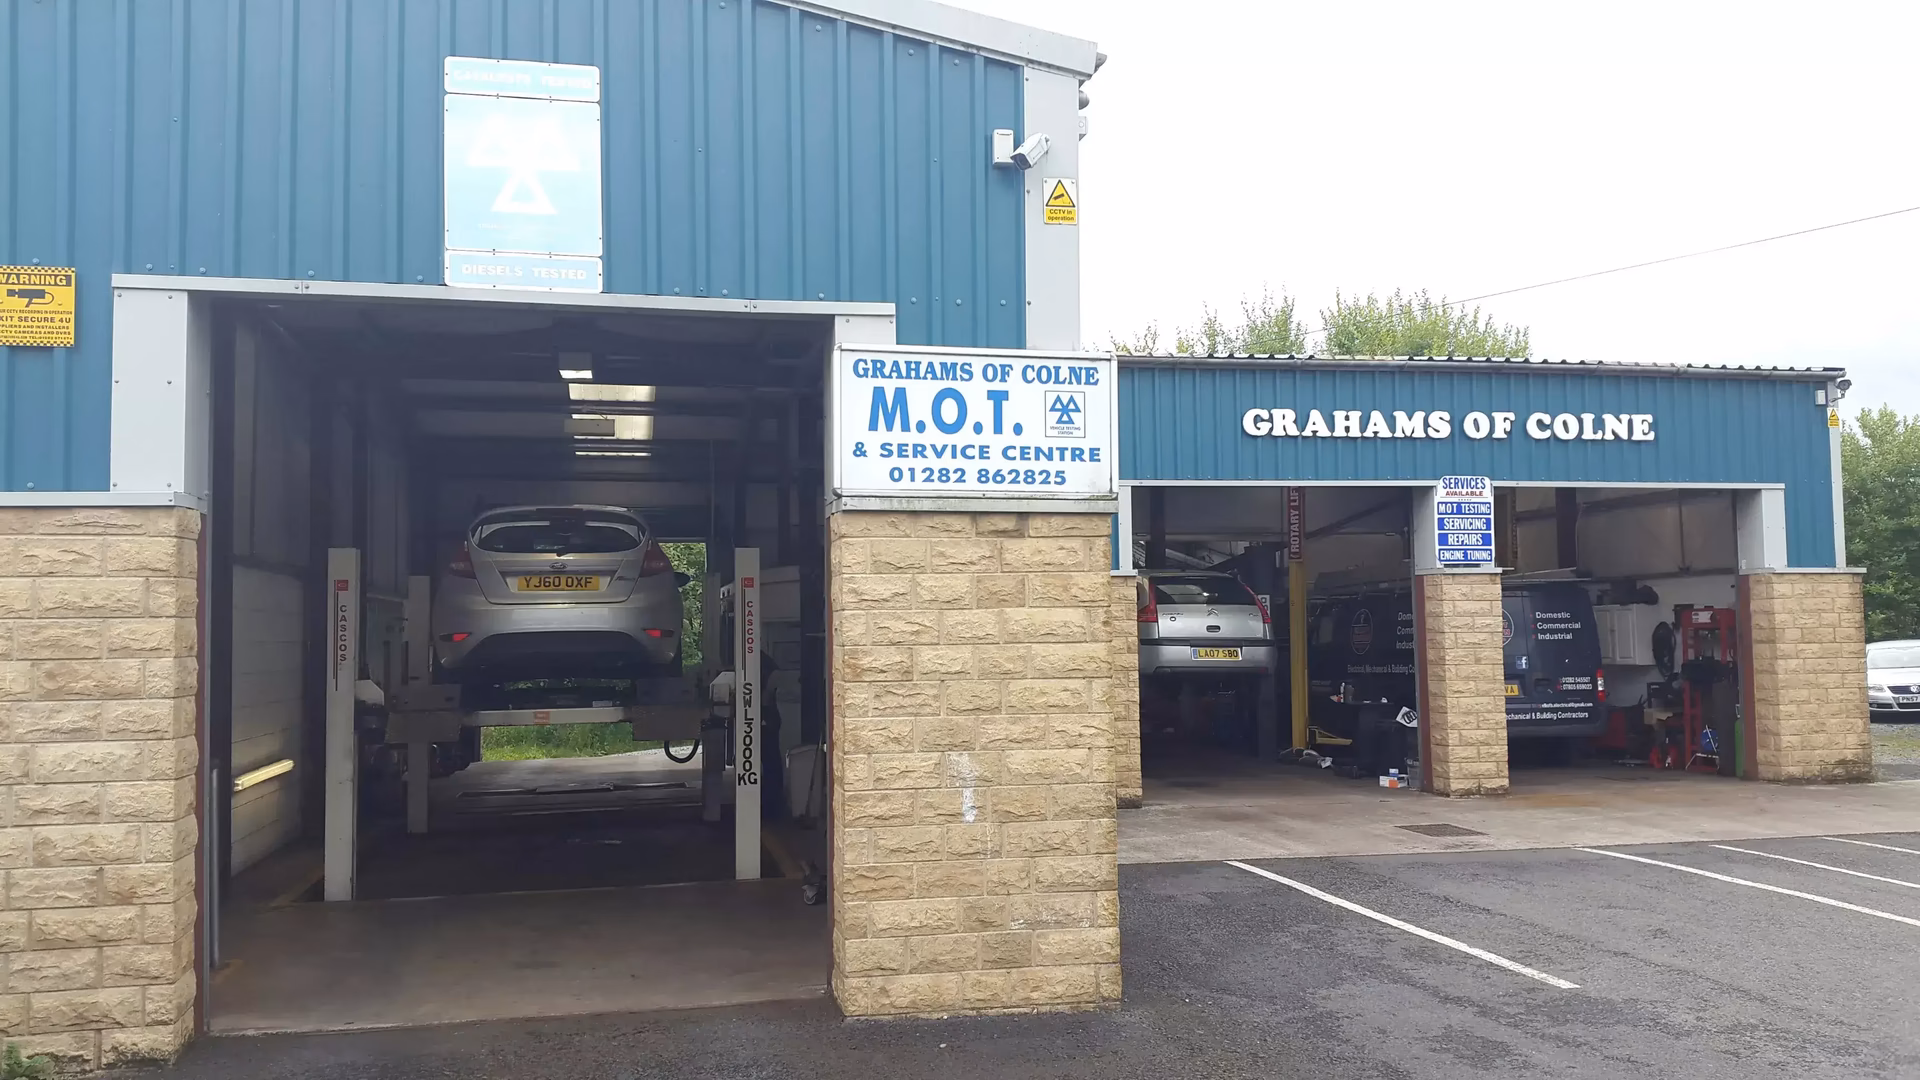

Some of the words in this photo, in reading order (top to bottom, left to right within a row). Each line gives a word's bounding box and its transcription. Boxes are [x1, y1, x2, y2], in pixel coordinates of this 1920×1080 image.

[461, 263, 523, 277] DIESELS
[532, 267, 587, 280] TESTED
[0, 273, 66, 285] WARNING
[17, 315, 56, 323] SECURE
[852, 358, 974, 382] GRAHAMS
[982, 362, 1013, 383] OF
[1021, 364, 1100, 386] COLNE
[868, 386, 1024, 436] M.O.T.
[1242, 407, 1452, 440] GRAHAMS
[1462, 410, 1516, 440] OF
[1526, 411, 1656, 442] COLNE
[852, 441, 868, 458] &
[879, 442, 991, 460] SERVICE
[1001, 445, 1101, 463] CENTRE
[889, 466, 967, 484] 01282
[976, 468, 1067, 486] 862825
[1442, 477, 1486, 490] SERVICES
[1438, 503, 1458, 514] MOT
[1460, 503, 1491, 514] TESTING
[1443, 517, 1487, 530] SERVICING
[1290, 509, 1300, 553] ROTARY
[1447, 533, 1483, 546] REPAIRS
[1440, 549, 1465, 560] ENGINE
[1466, 550, 1491, 561] TUNING
[524, 576, 561, 588] YJ60
[565, 576, 593, 588] OXF
[1535, 611, 1571, 619] Domestic
[339, 604, 347, 661] CASCOS
[746, 600, 754, 654] CASCOS
[1537, 632, 1573, 640] Industrial
[1197, 649, 1220, 658] LA07
[1536, 712, 1557, 720] Building
[1557, 711, 1589, 719] Contractors
